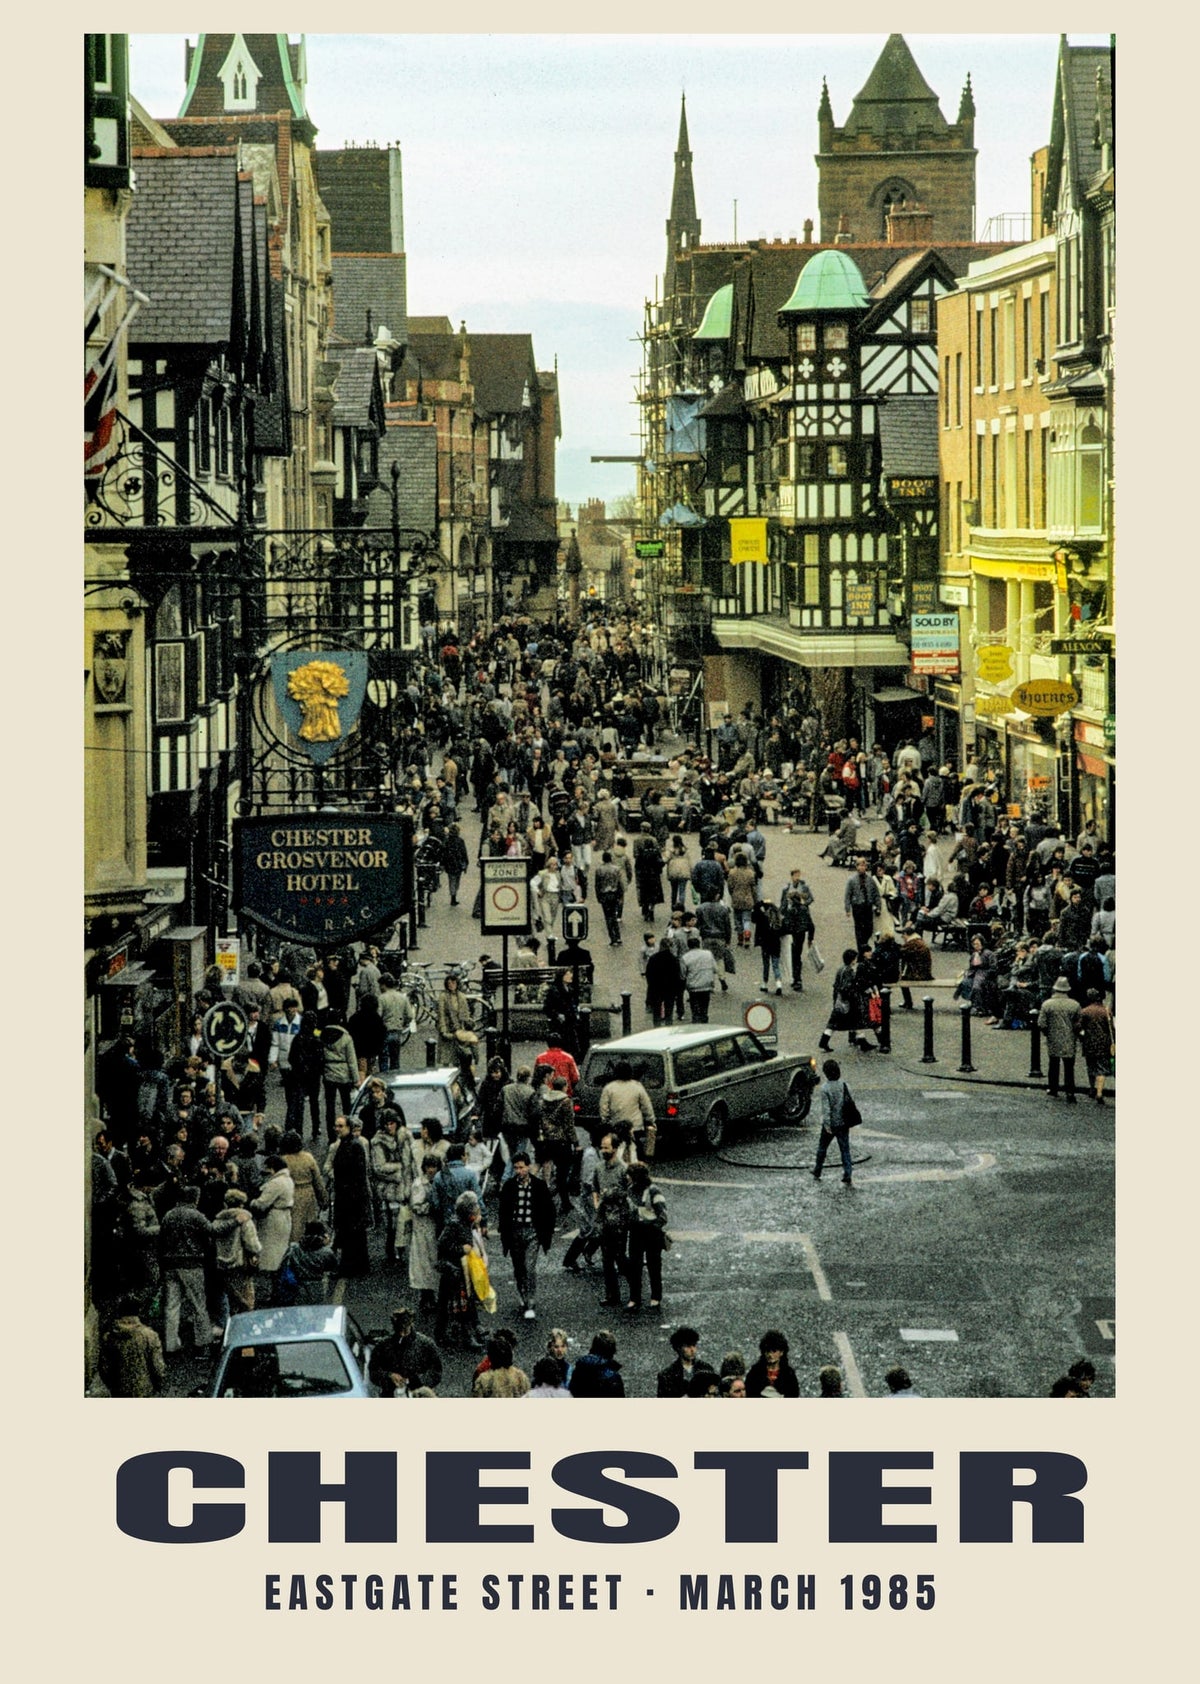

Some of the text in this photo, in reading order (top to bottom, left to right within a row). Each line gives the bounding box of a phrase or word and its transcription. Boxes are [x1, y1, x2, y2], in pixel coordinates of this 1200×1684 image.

[892, 480, 934, 489] BOOT
[900, 487, 926, 496] INN
[912, 584, 933, 592] BOOT
[848, 592, 873, 600] BOOT
[851, 601, 870, 609] INN
[915, 618, 955, 626] SOLD BY
[1062, 642, 1101, 652] ALEXON
[271, 828, 373, 847] CHESTER
[256, 850, 389, 869] GROSVENOR
[493, 869, 518, 877] ZONE
[286, 873, 359, 891] HOTEL
